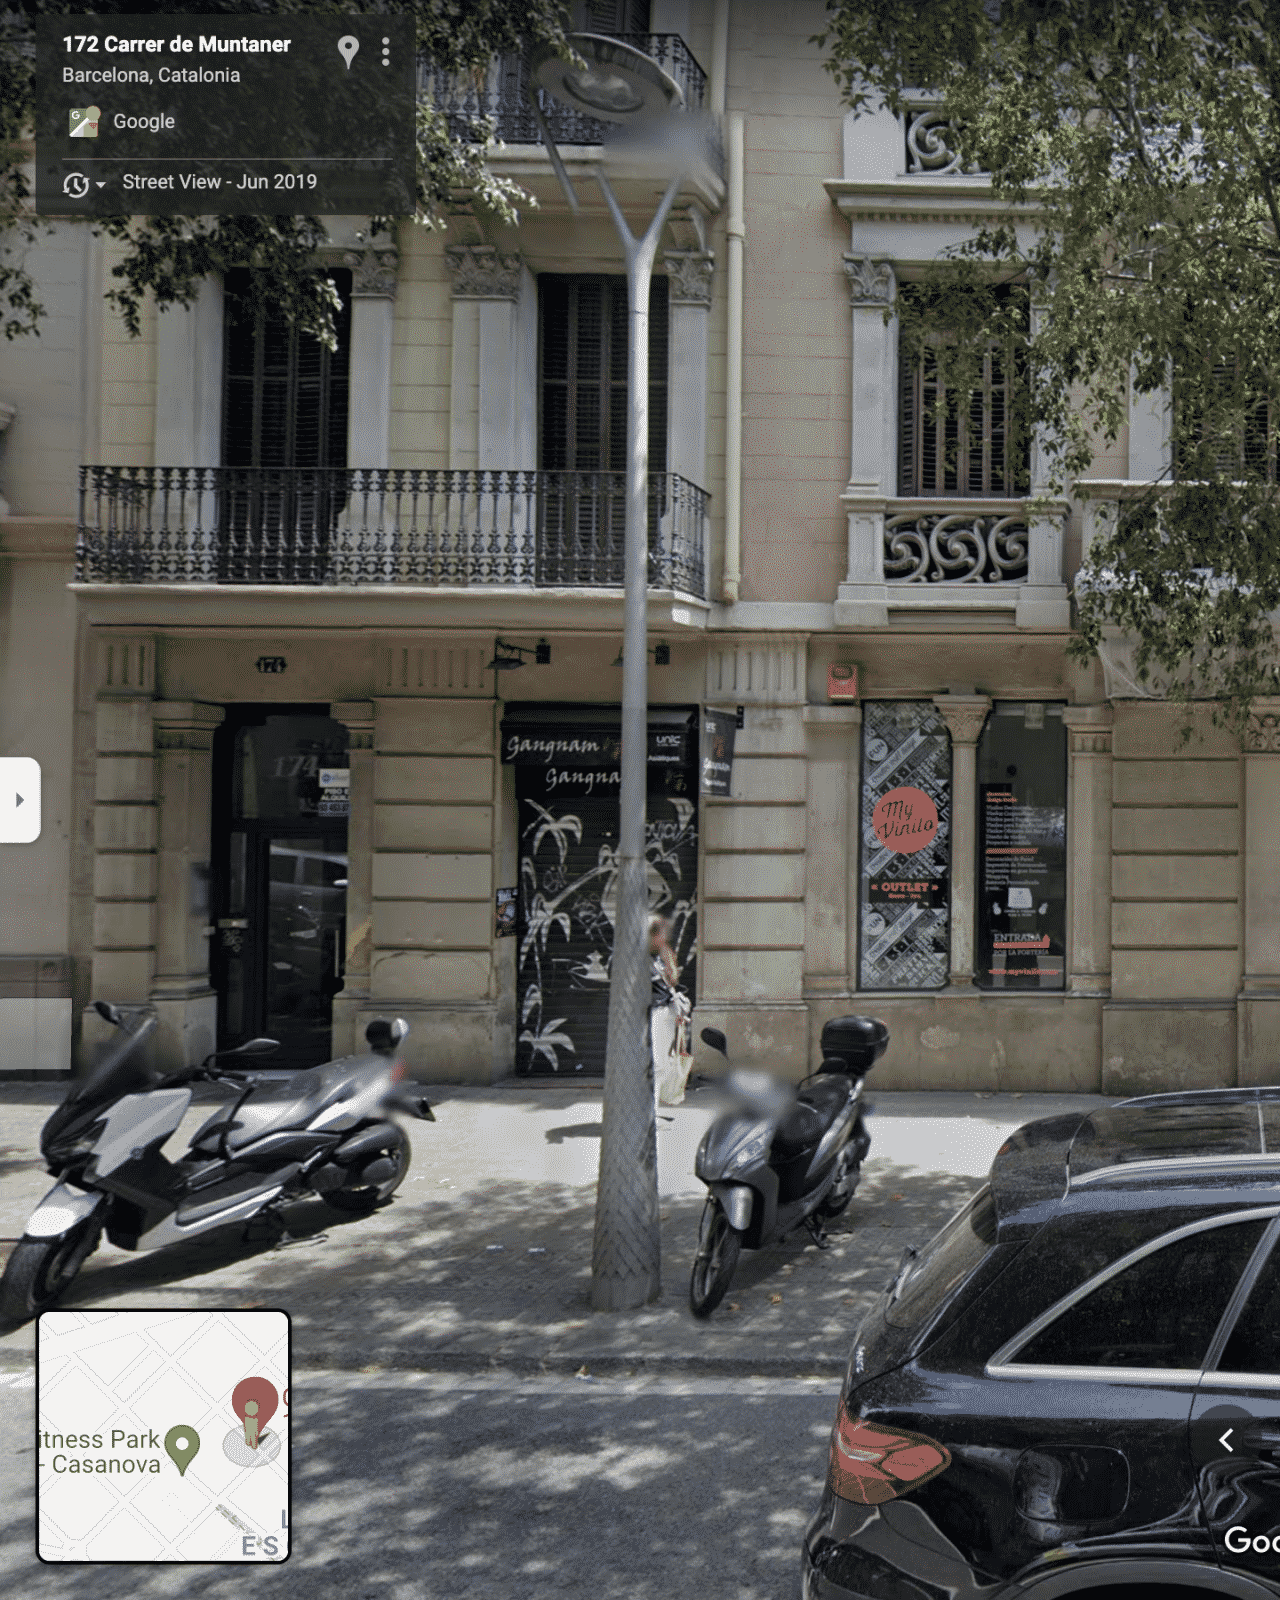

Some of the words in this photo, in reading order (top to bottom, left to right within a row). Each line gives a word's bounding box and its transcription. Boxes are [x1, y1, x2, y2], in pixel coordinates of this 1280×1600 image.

[506, 736, 600, 762] Gangnam
[272, 756, 318, 777] 174
[545, 768, 620, 794] Gangna
[881, 800, 914, 821] My
[877, 817, 934, 839] Vinilo
[881, 882, 930, 892] OUTLET
[994, 933, 1042, 942] ENTRADA
